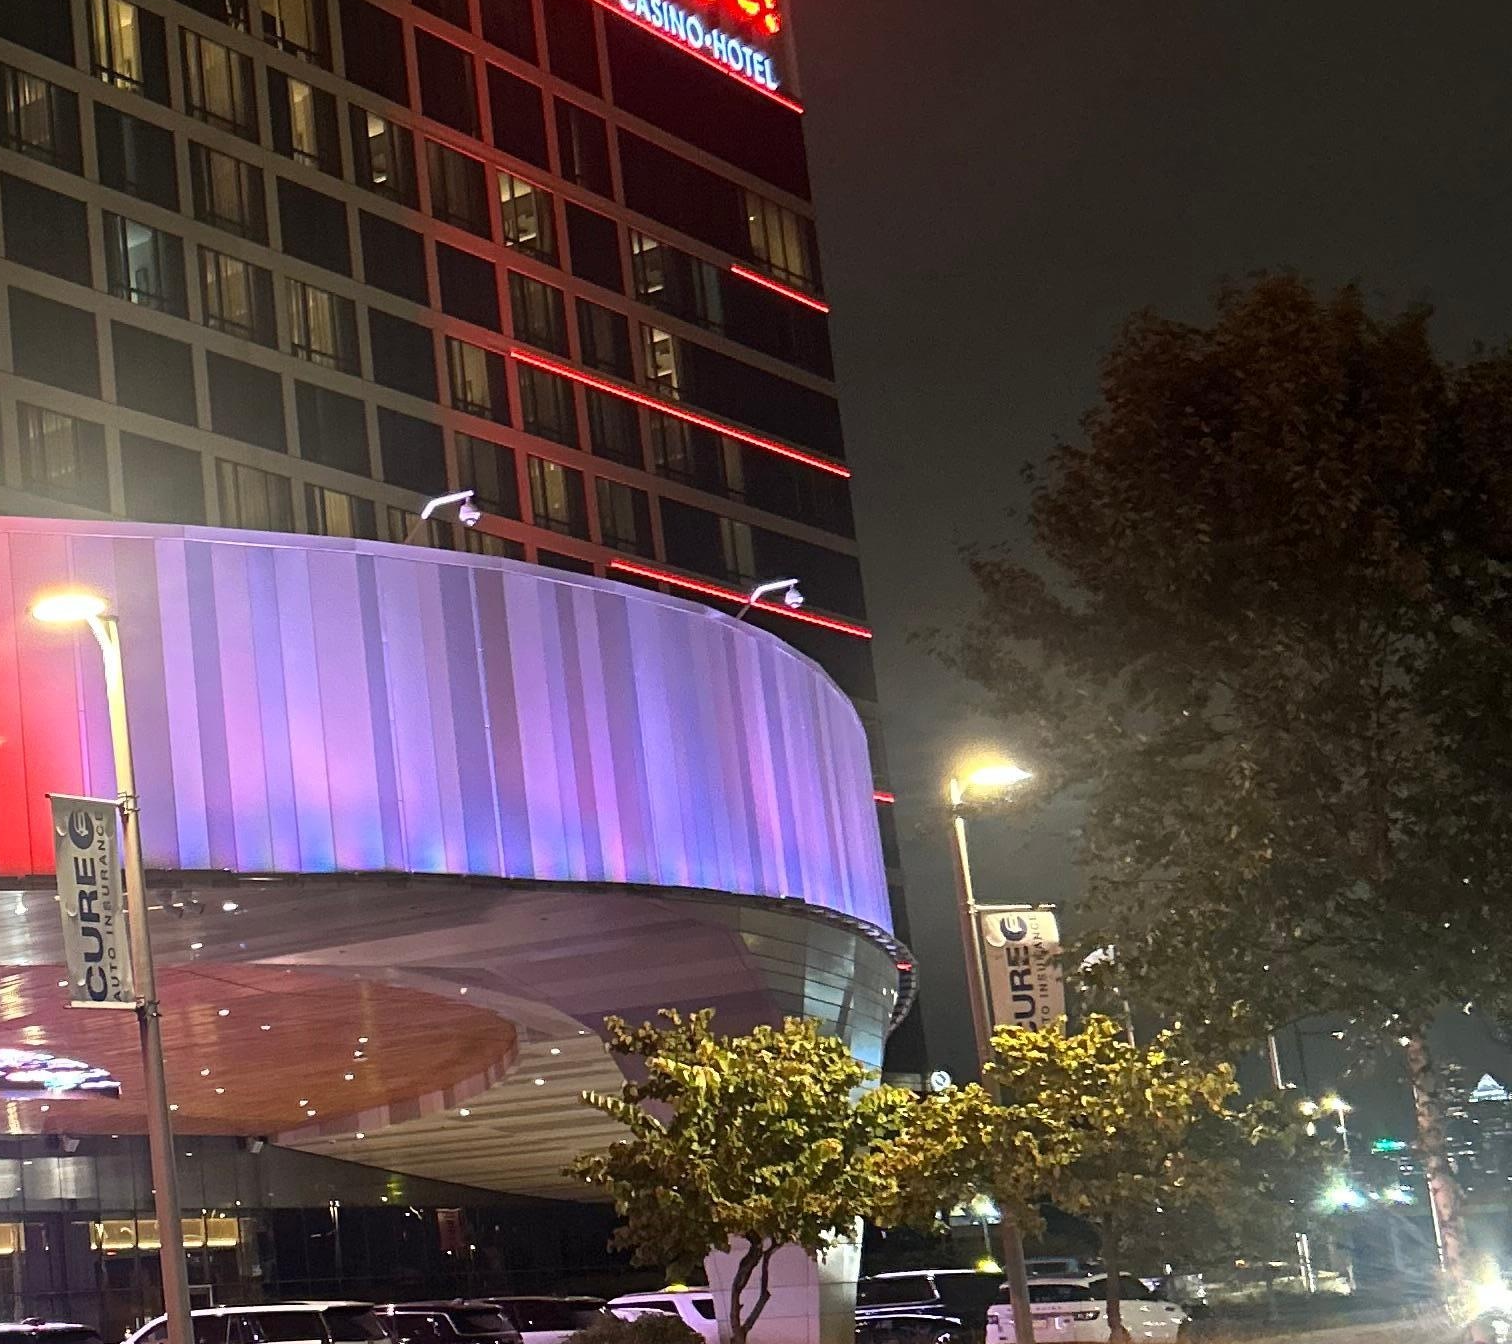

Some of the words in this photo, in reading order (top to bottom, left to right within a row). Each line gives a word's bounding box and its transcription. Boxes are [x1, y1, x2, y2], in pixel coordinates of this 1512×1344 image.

[73, 856, 108, 1002] CURE
[95, 810, 115, 935] INSURANCE
[107, 947, 122, 1002] AUTO
